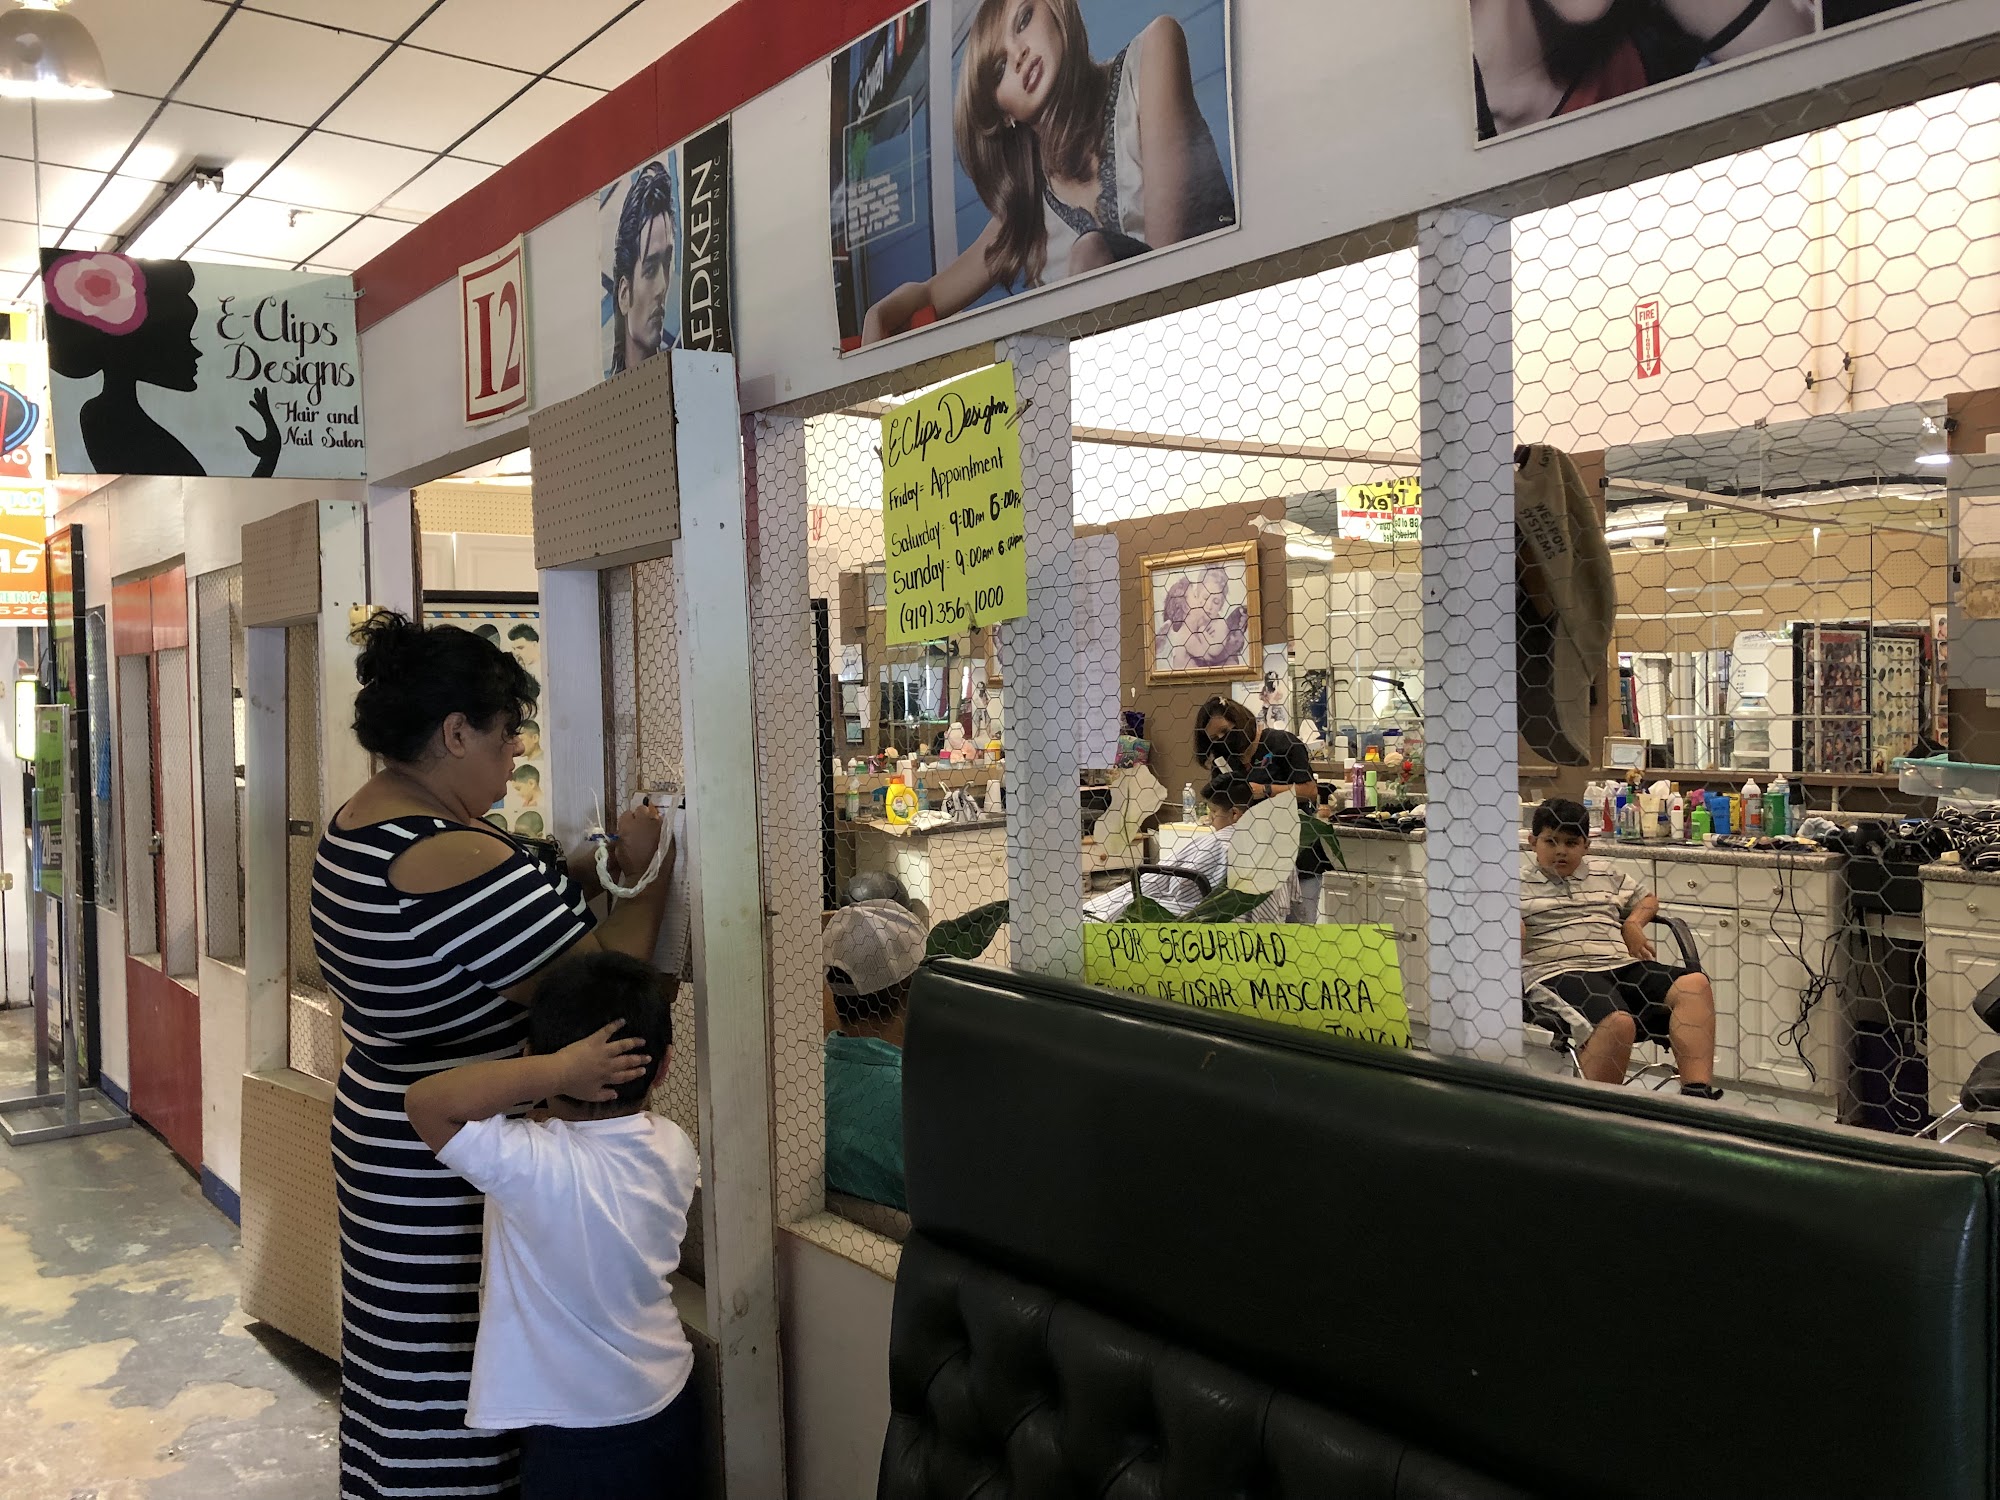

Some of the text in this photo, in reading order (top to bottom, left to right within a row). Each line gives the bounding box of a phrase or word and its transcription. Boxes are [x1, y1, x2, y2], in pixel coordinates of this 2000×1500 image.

[713, 155, 721, 198] NYC
[713, 217, 721, 308] AVENUE
[216, 296, 339, 357] E-Clips
[1639, 308, 1655, 322] FIRE
[223, 341, 355, 406] Designs
[275, 401, 360, 426] Hair and
[282, 425, 365, 449] Nail Salon
[937, 392, 1009, 444] Designs
[930, 446, 1004, 500] Appointment
[1518, 508, 1557, 561] SYSTEMS
[1534, 501, 1568, 554] WEAPON
[899, 585, 1004, 634] (919) 356 1000
[1107, 926, 1287, 967] POR SEGURIDAD
[1249, 977, 1376, 1014] MASCARA
